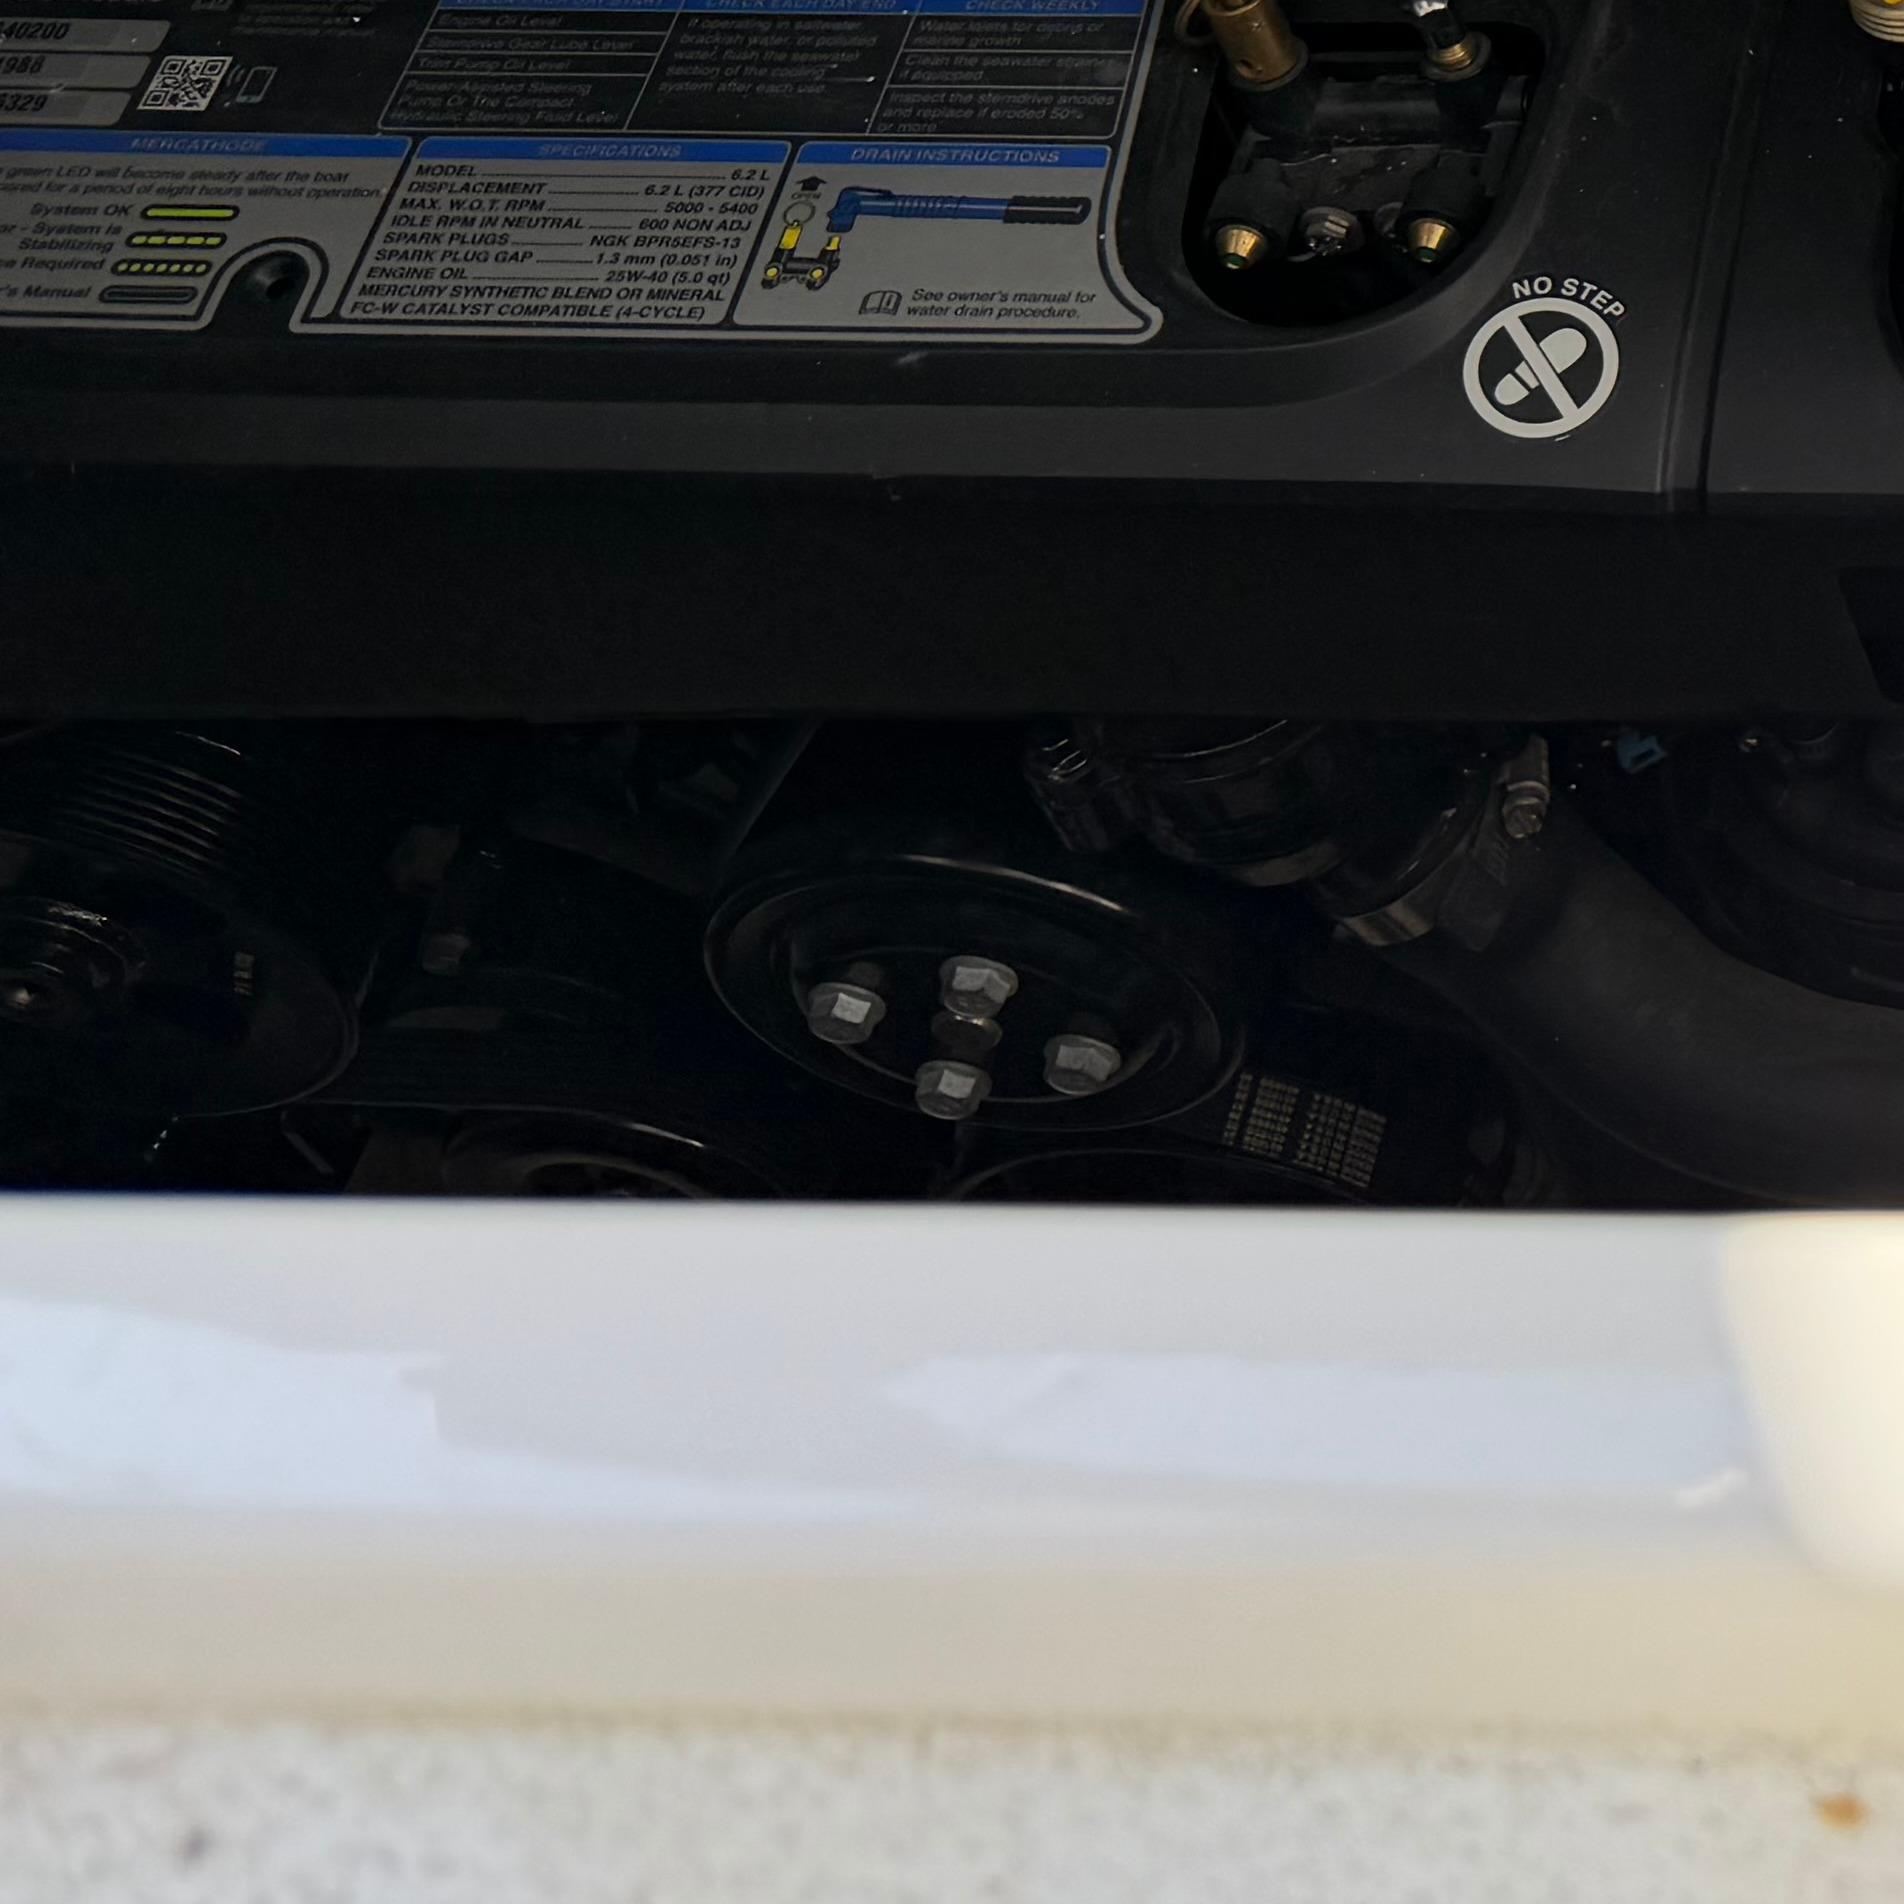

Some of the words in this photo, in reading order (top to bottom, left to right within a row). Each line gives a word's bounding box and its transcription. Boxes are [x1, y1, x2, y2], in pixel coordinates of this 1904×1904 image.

[540, 144, 681, 157] SPECIFICATIONS
[851, 148, 911, 161] DRAIN
[915, 149, 1060, 163] INSTRUCTIONS
[416, 165, 478, 177] MODEL
[731, 170, 759, 181] 6.2
[759, 170, 771, 181] L
[408, 182, 548, 194] DISPLACEMENT
[644, 185, 669, 196] 6.2
[674, 185, 686, 196] L
[689, 185, 725, 198] (377
[730, 186, 764, 198] CID)
[400, 198, 441, 210] MAX.
[449, 199, 499, 211] W.O.T.
[505, 199, 546, 211] RPM
[664, 202, 703, 213] 5000
[719, 203, 758, 214] 5400
[392, 215, 433, 227] IDLE
[437, 216, 477, 227] RPM
[480, 216, 499, 228] IN
[503, 217, 585, 229] NEUTRAL
[638, 219, 669, 230] 600
[674, 219, 713, 230] NON
[716, 220, 751, 232] ADJ
[384, 232, 444, 244] SPARK
[449, 233, 510, 245] PLUGS
[590, 236, 628, 247] NGK
[375, 249, 437, 261] SPARK
[441, 250, 489, 262] PLUG
[494, 250, 533, 263] GAP
[595, 253, 619, 264] 1.3
[623, 255, 655, 265] mm
[660, 253, 709, 267] (0.051
[714, 254, 737, 268] in)
[367, 267, 435, 279] ENGINE
[440, 268, 468, 280] OIL
[605, 271, 667, 283] 25W-40
[671, 271, 704, 284] (5.0
[709, 272, 730, 285] qt)
[358, 285, 446, 297] MERCURY
[449, 286, 549, 298] SYNTHETIC
[553, 287, 612, 299] BLEND
[616, 288, 641, 300] OR
[645, 289, 725, 301] MINERAL
[913, 290, 944, 302] See
[948, 290, 1008, 303] owner's
[1012, 291, 1071, 303] manual
[1074, 291, 1096, 303] for
[1512, 275, 1553, 298] NO
[1560, 277, 1625, 318] STEP
[350, 302, 398, 314] FC-W
[403, 303, 492, 315] CATALYST
[495, 304, 612, 317] COMPATIBLE
[616, 305, 705, 319] (4-CYCLE)
[906, 305, 950, 317] water
[955, 305, 993, 317] drain
